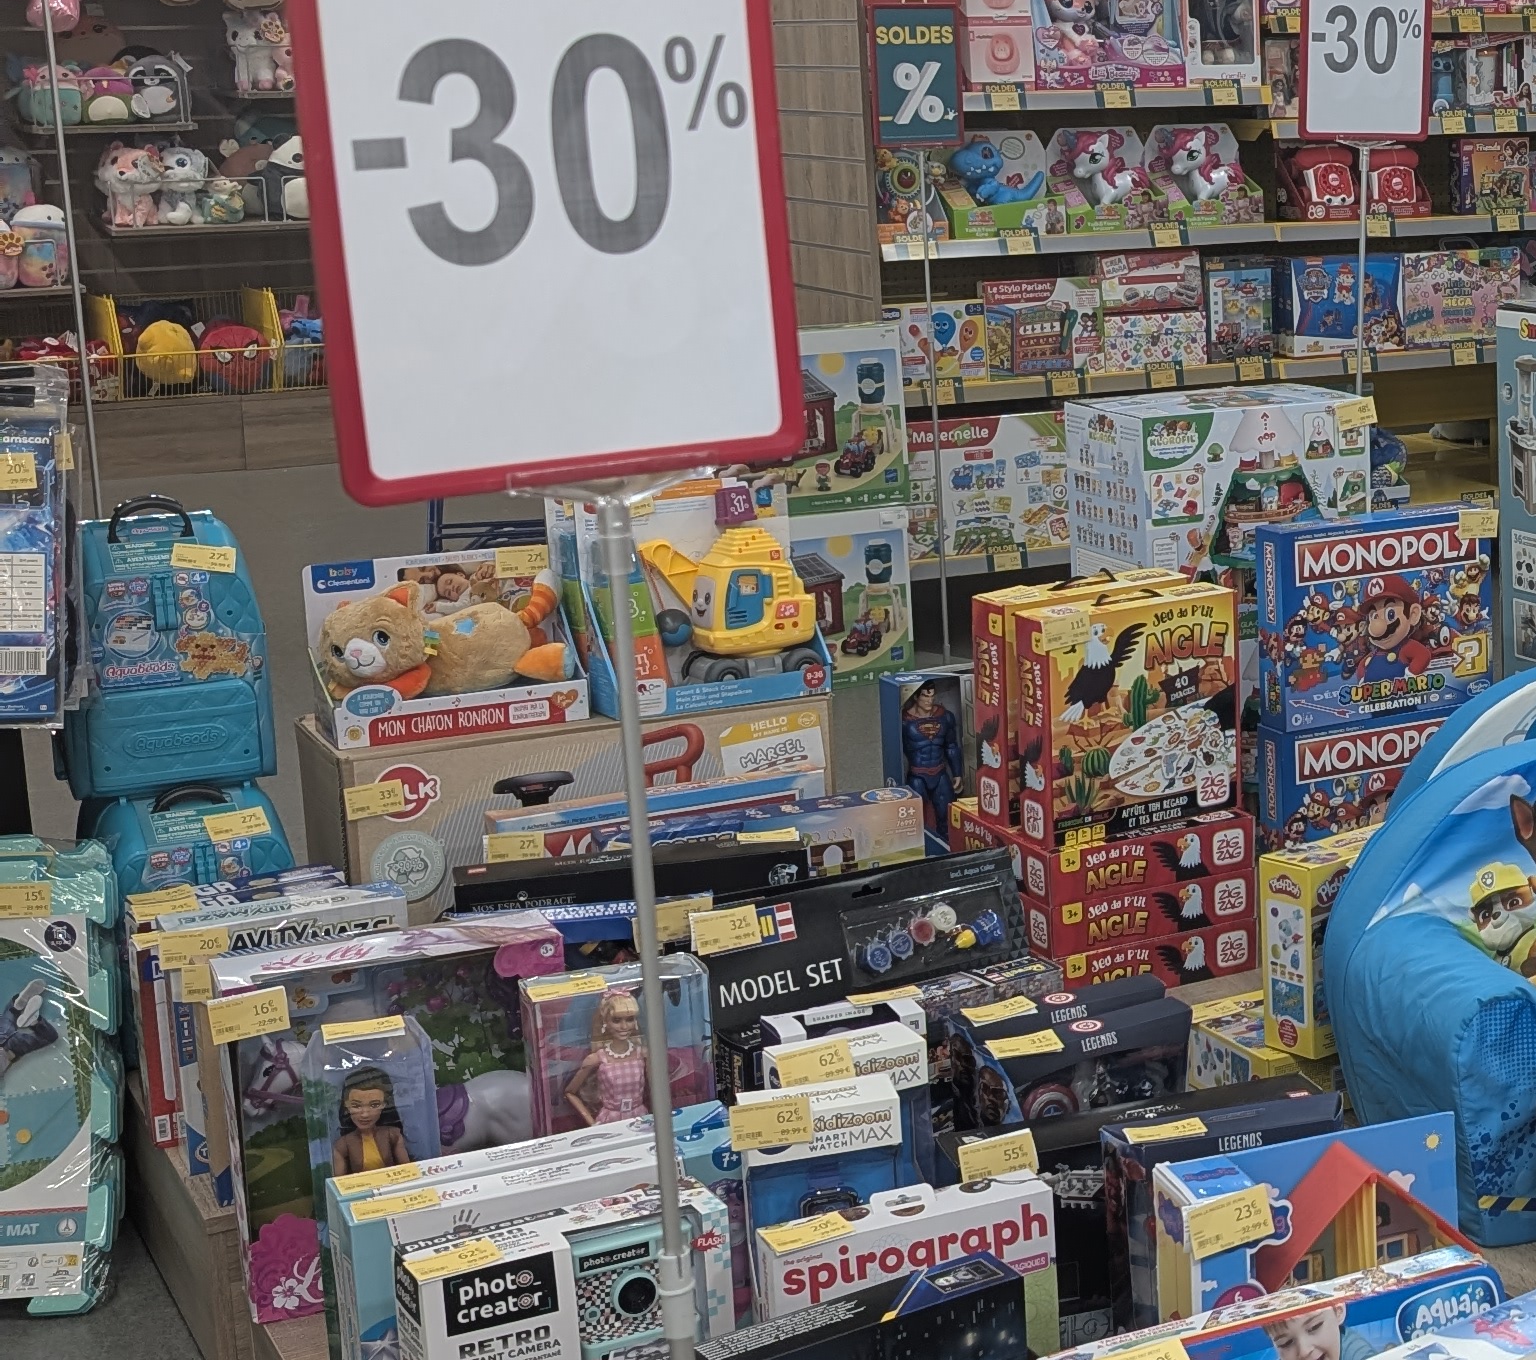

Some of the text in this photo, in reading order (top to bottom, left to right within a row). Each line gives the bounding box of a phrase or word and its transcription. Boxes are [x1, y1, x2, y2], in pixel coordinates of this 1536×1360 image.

[876, 25, 954, 45] SOLDES
[1311, 4, 1421, 75] -30%
[352, 32, 748, 267] -30%
[999, 284, 1021, 294] Stylo
[1022, 282, 1051, 291] Parlant
[1303, 531, 1474, 585] MONOPOLY
[317, 577, 371, 589] Clementoni
[329, 567, 358, 578] baby
[1144, 621, 1228, 670] AIGLE
[105, 663, 175, 679] Aquabeads
[1175, 675, 1188, 689] 40
[377, 709, 505, 737] MON CHATON RONRON
[750, 716, 788, 732] HELLO
[739, 739, 805, 771] MARCEL
[719, 958, 844, 1007] MODEL SET
[1051, 1005, 1087, 1023] LEGENDS
[783, 1203, 1048, 1303] spirograph
[459, 1325, 550, 1360] RETRO
